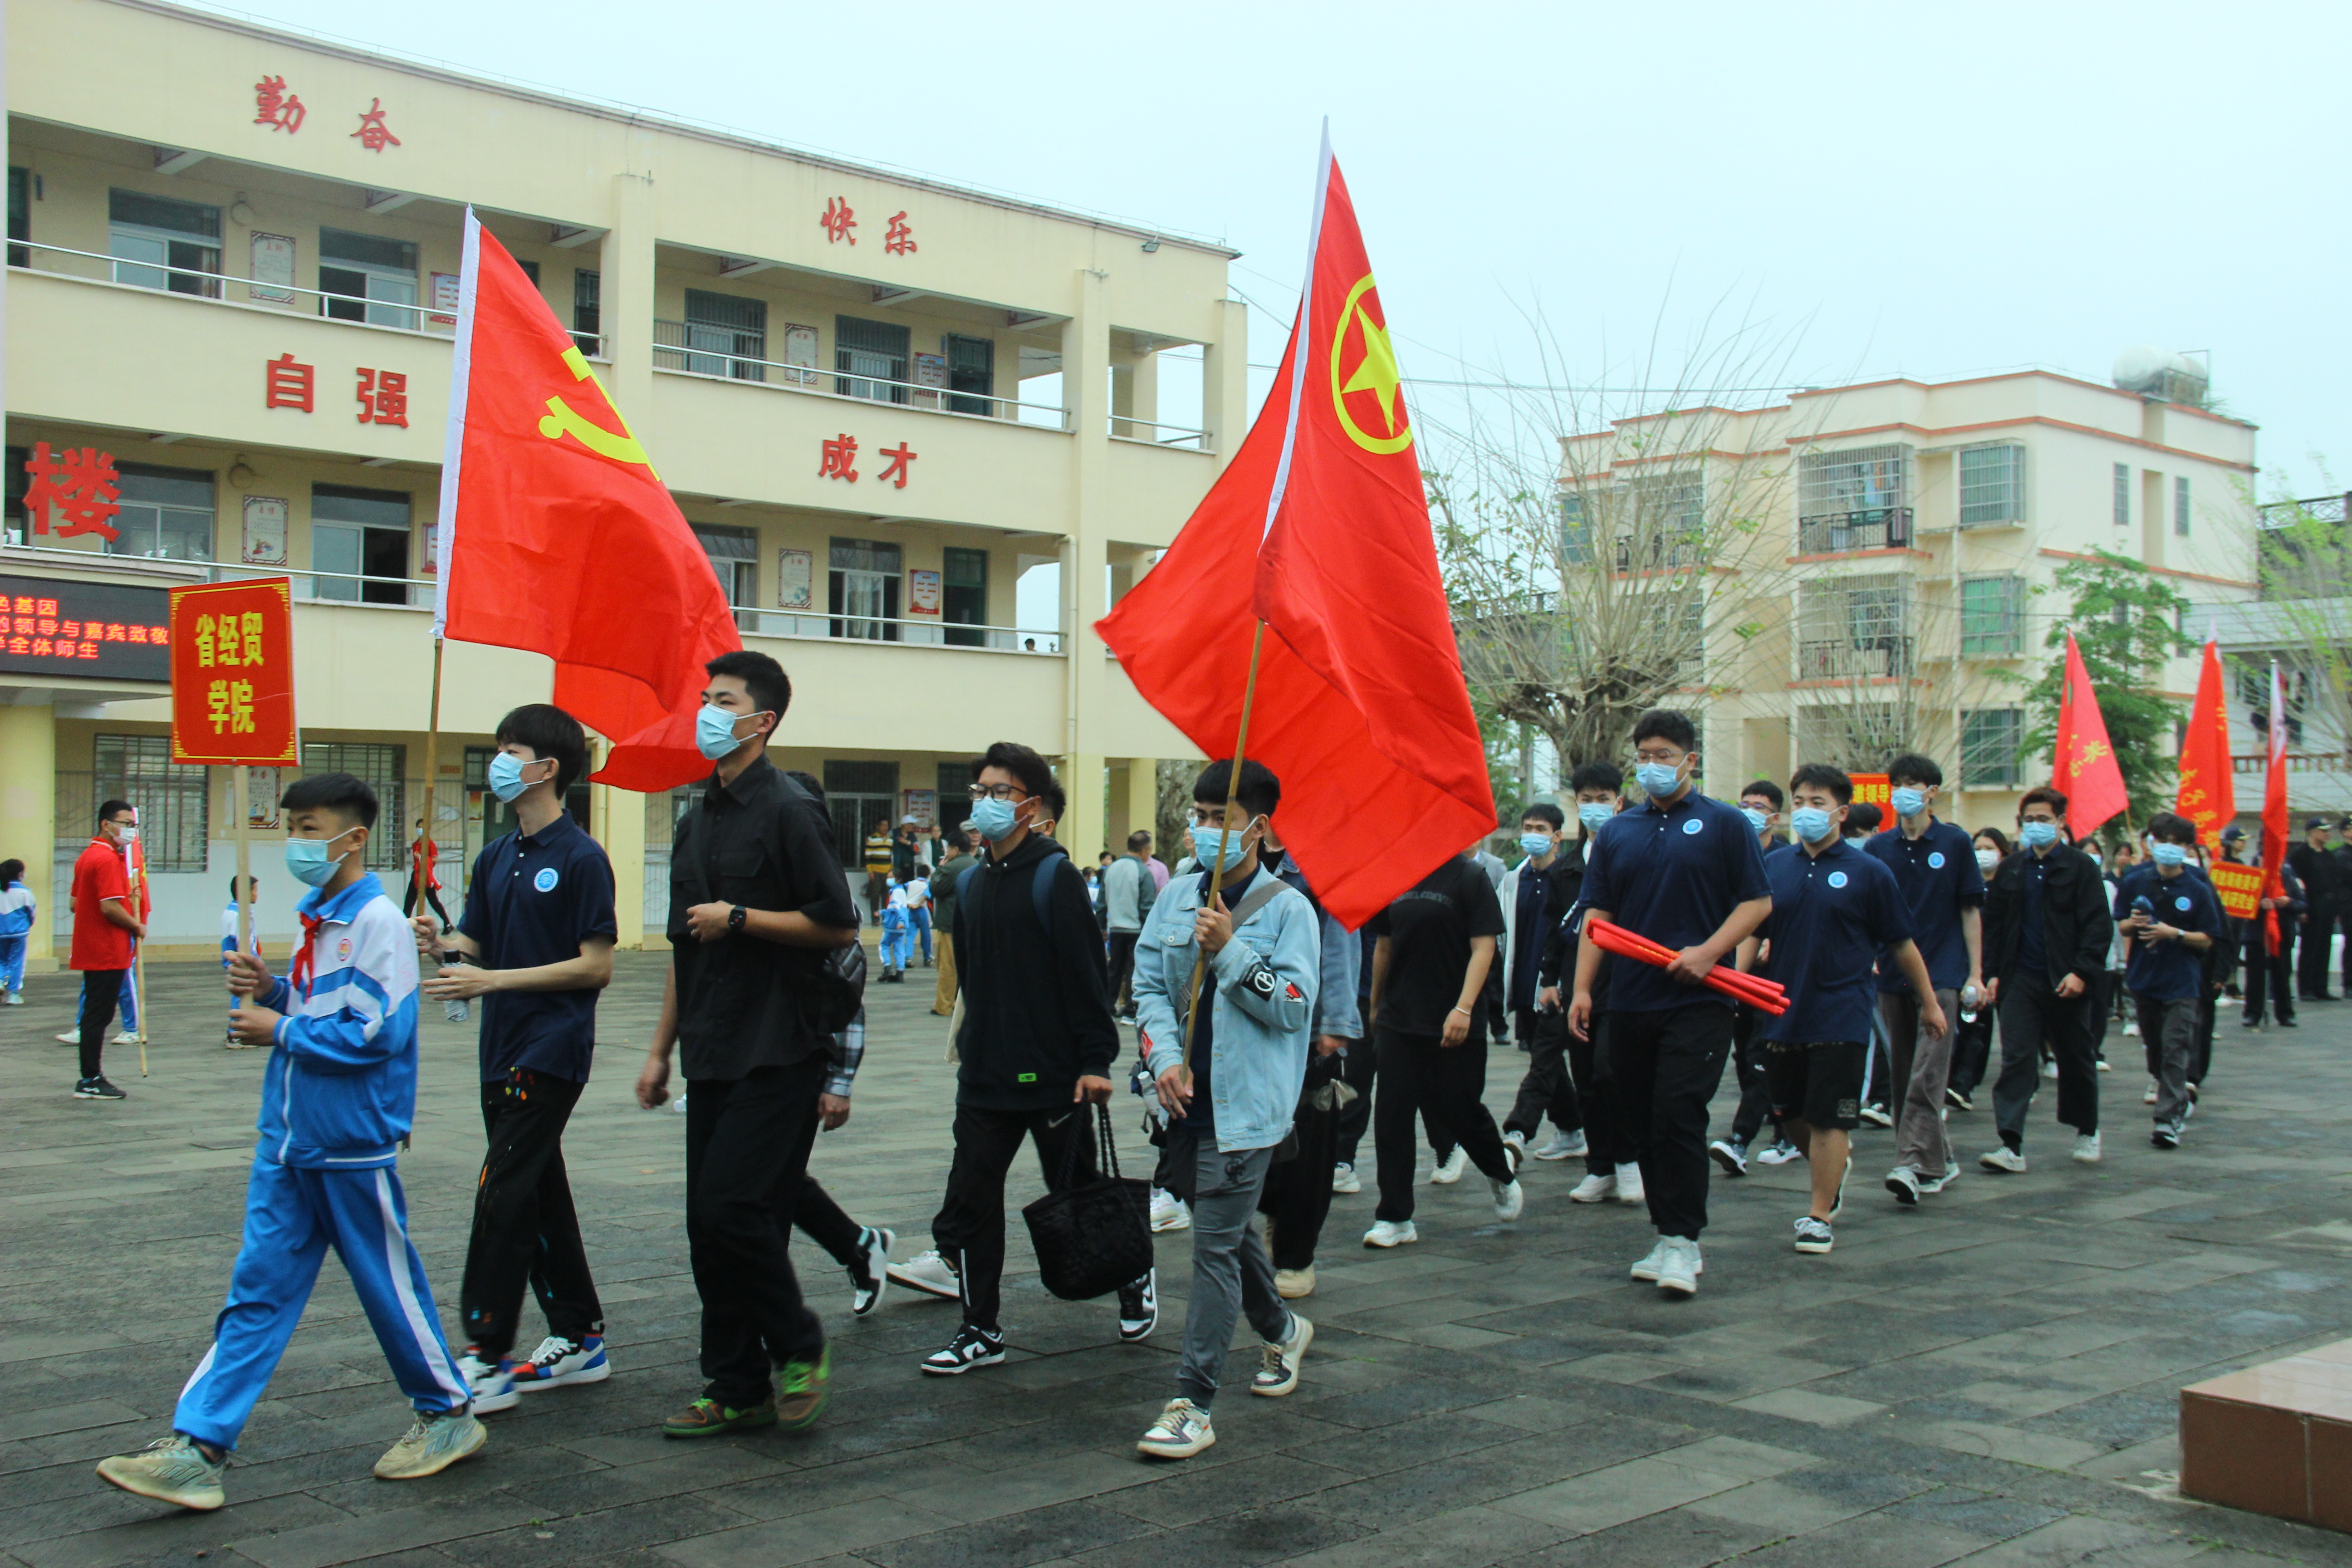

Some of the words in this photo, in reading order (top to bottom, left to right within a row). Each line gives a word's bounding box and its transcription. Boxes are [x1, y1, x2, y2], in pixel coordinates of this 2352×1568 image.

[254, 75, 402, 153] 勤奋
[820, 196, 918, 256] 快乐
[267, 353, 409, 428] 自强
[818, 433, 917, 489] 成才
[22, 441, 122, 544] 楼
[0, 594, 59, 617] 色基因
[195, 611, 265, 668] 省经贸
[208, 678, 255, 734] 学院
